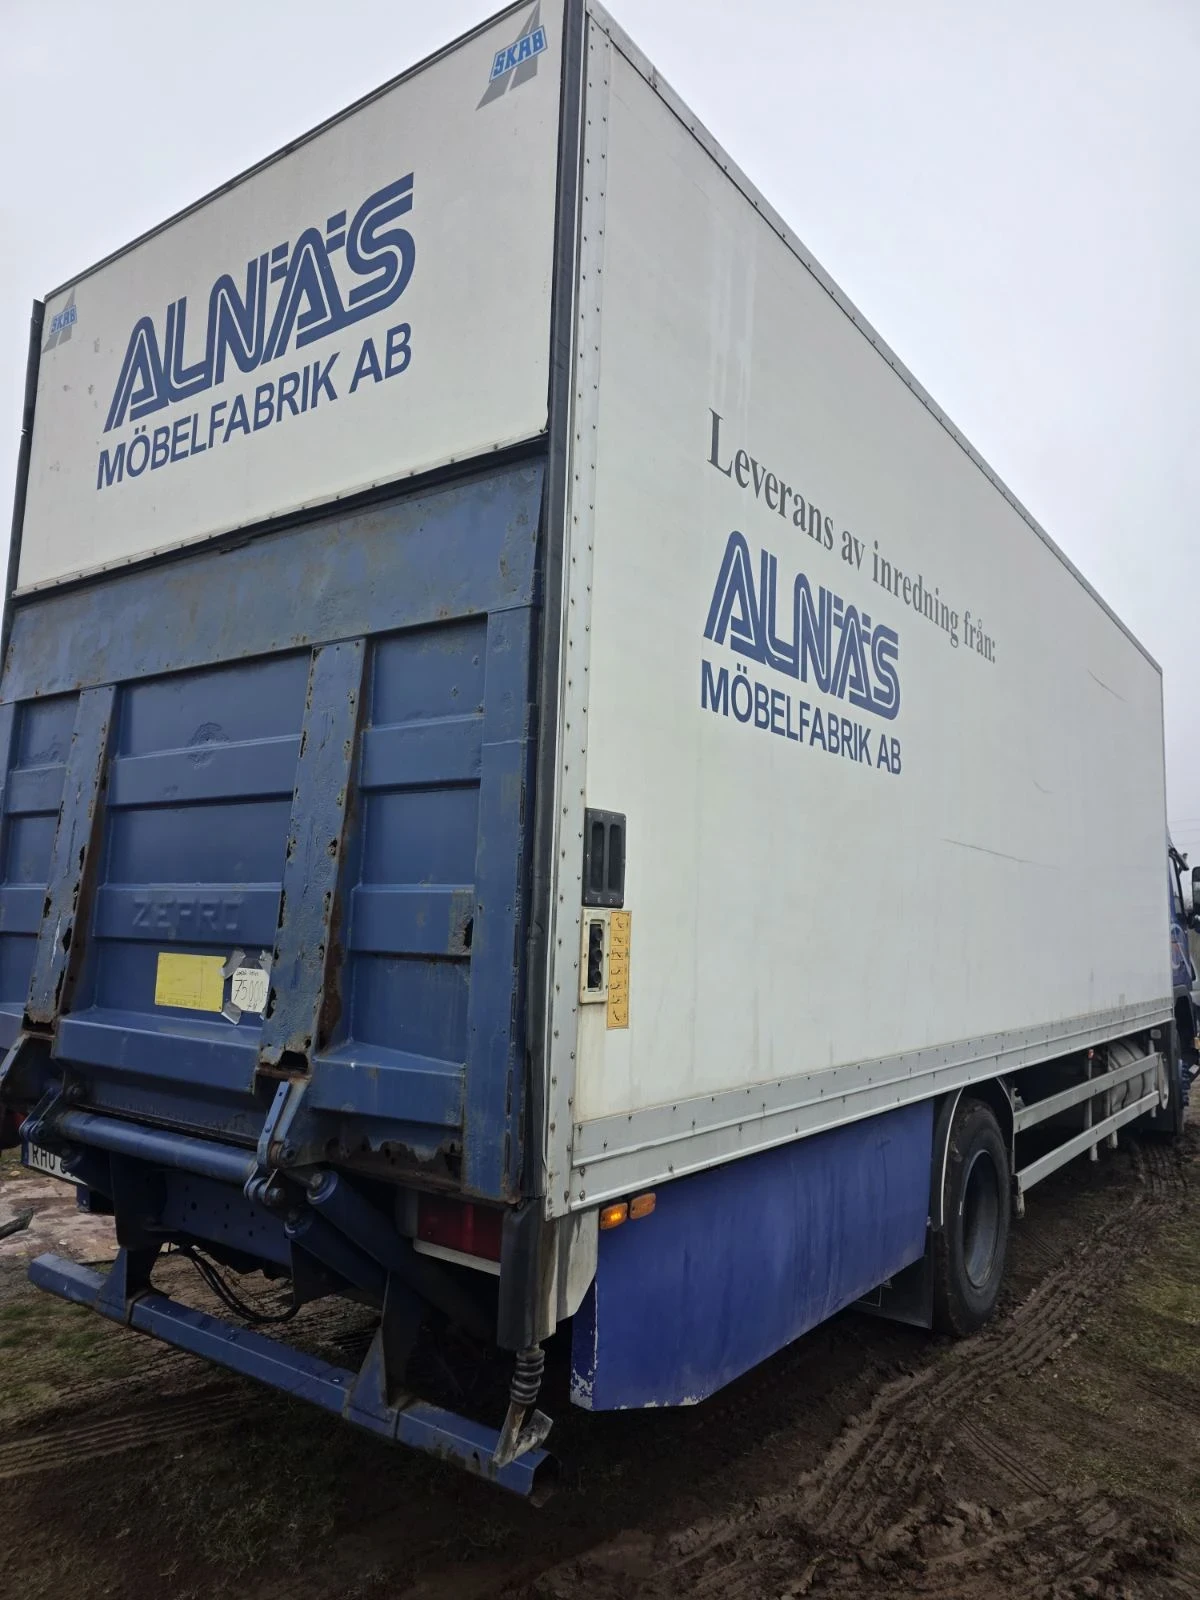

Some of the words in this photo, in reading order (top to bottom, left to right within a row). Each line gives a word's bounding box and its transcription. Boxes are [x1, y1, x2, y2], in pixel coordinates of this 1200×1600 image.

[492, 29, 545, 77] SKAB
[97, 351, 341, 490] MÖBELFABRIK
[348, 322, 412, 394] AB
[707, 407, 834, 551] Leverans
[841, 530, 865, 571] av
[872, 540, 959, 649] inredning
[963, 609, 996, 664] från:
[701, 658, 872, 767] MÖBELFABRIK
[876, 733, 902, 775] AB
